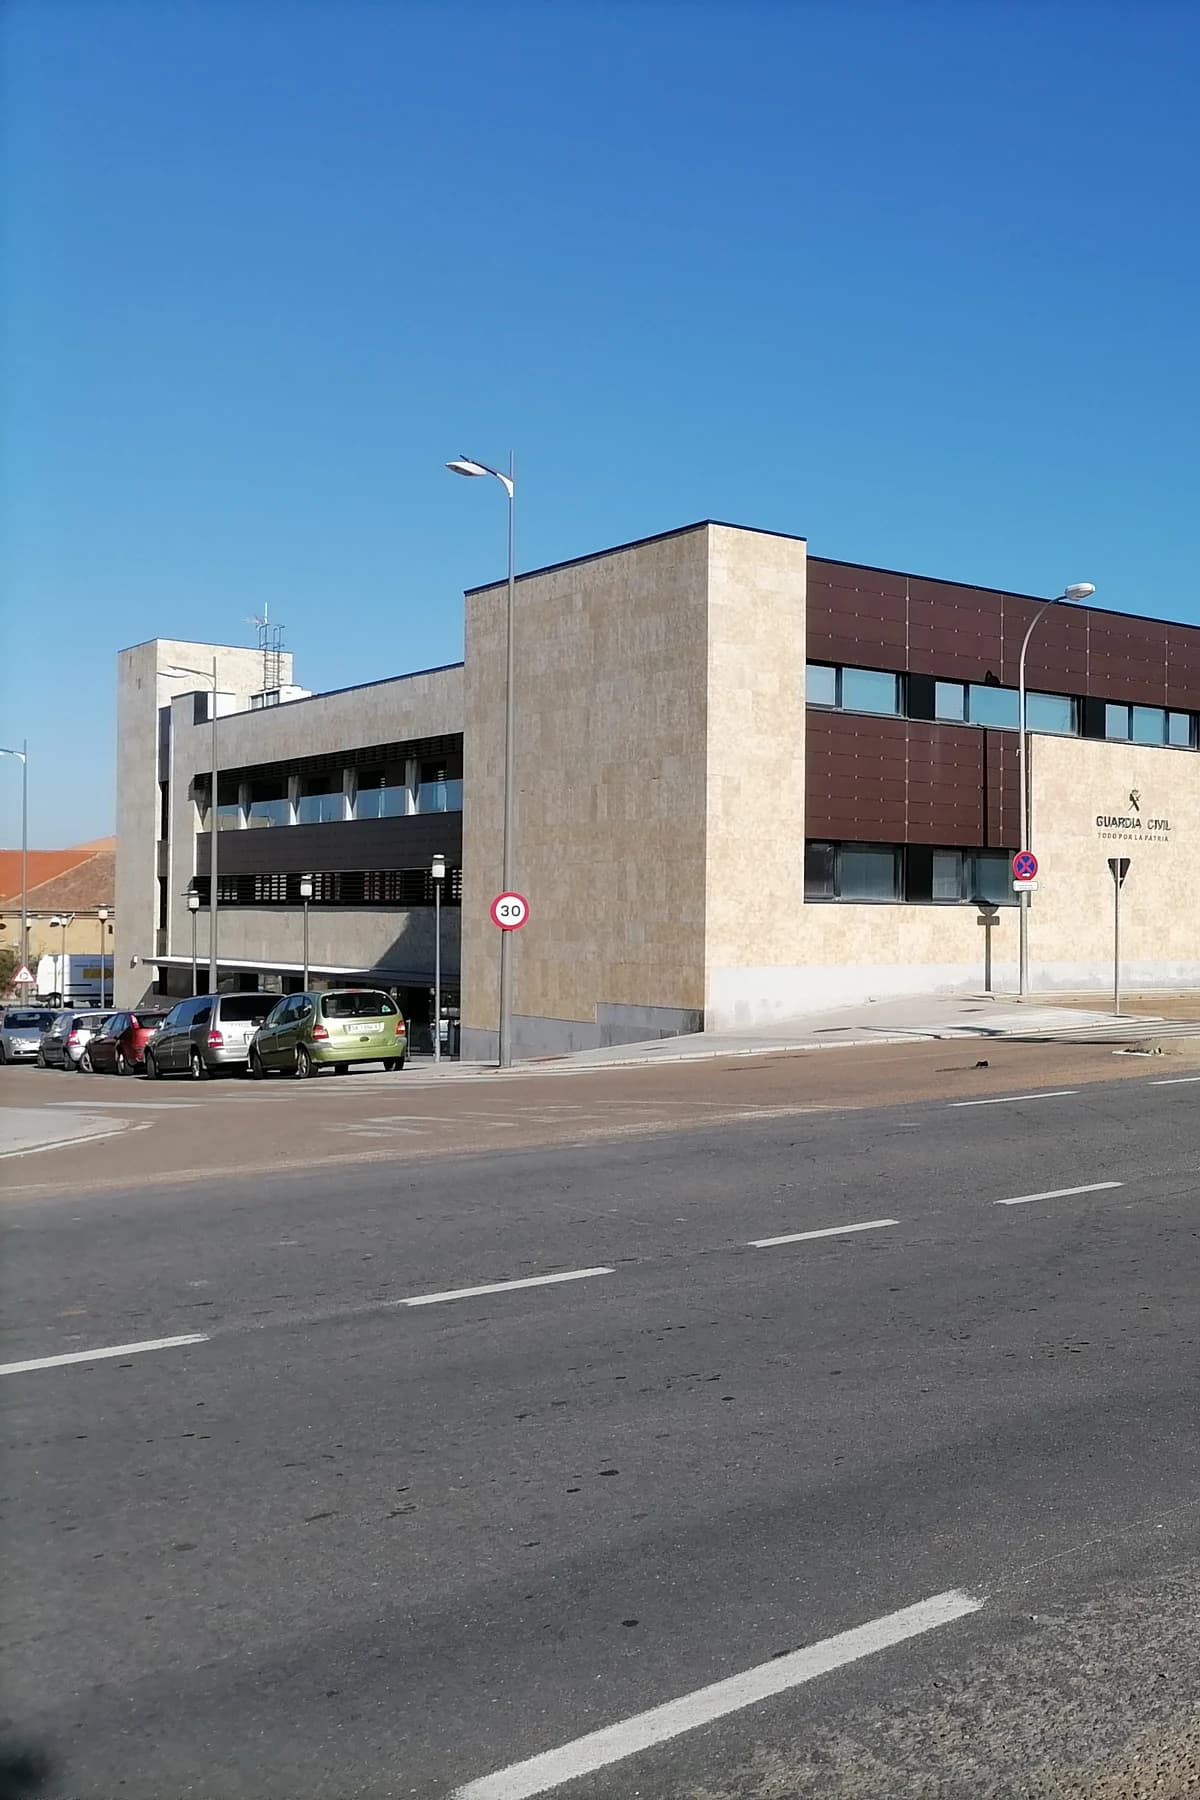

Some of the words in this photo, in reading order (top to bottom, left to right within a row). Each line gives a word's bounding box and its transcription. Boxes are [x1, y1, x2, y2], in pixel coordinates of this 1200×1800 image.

[1096, 816, 1142, 829] GUARDIA
[1147, 819, 1171, 831] CIVIL
[500, 905, 521, 917] 30
